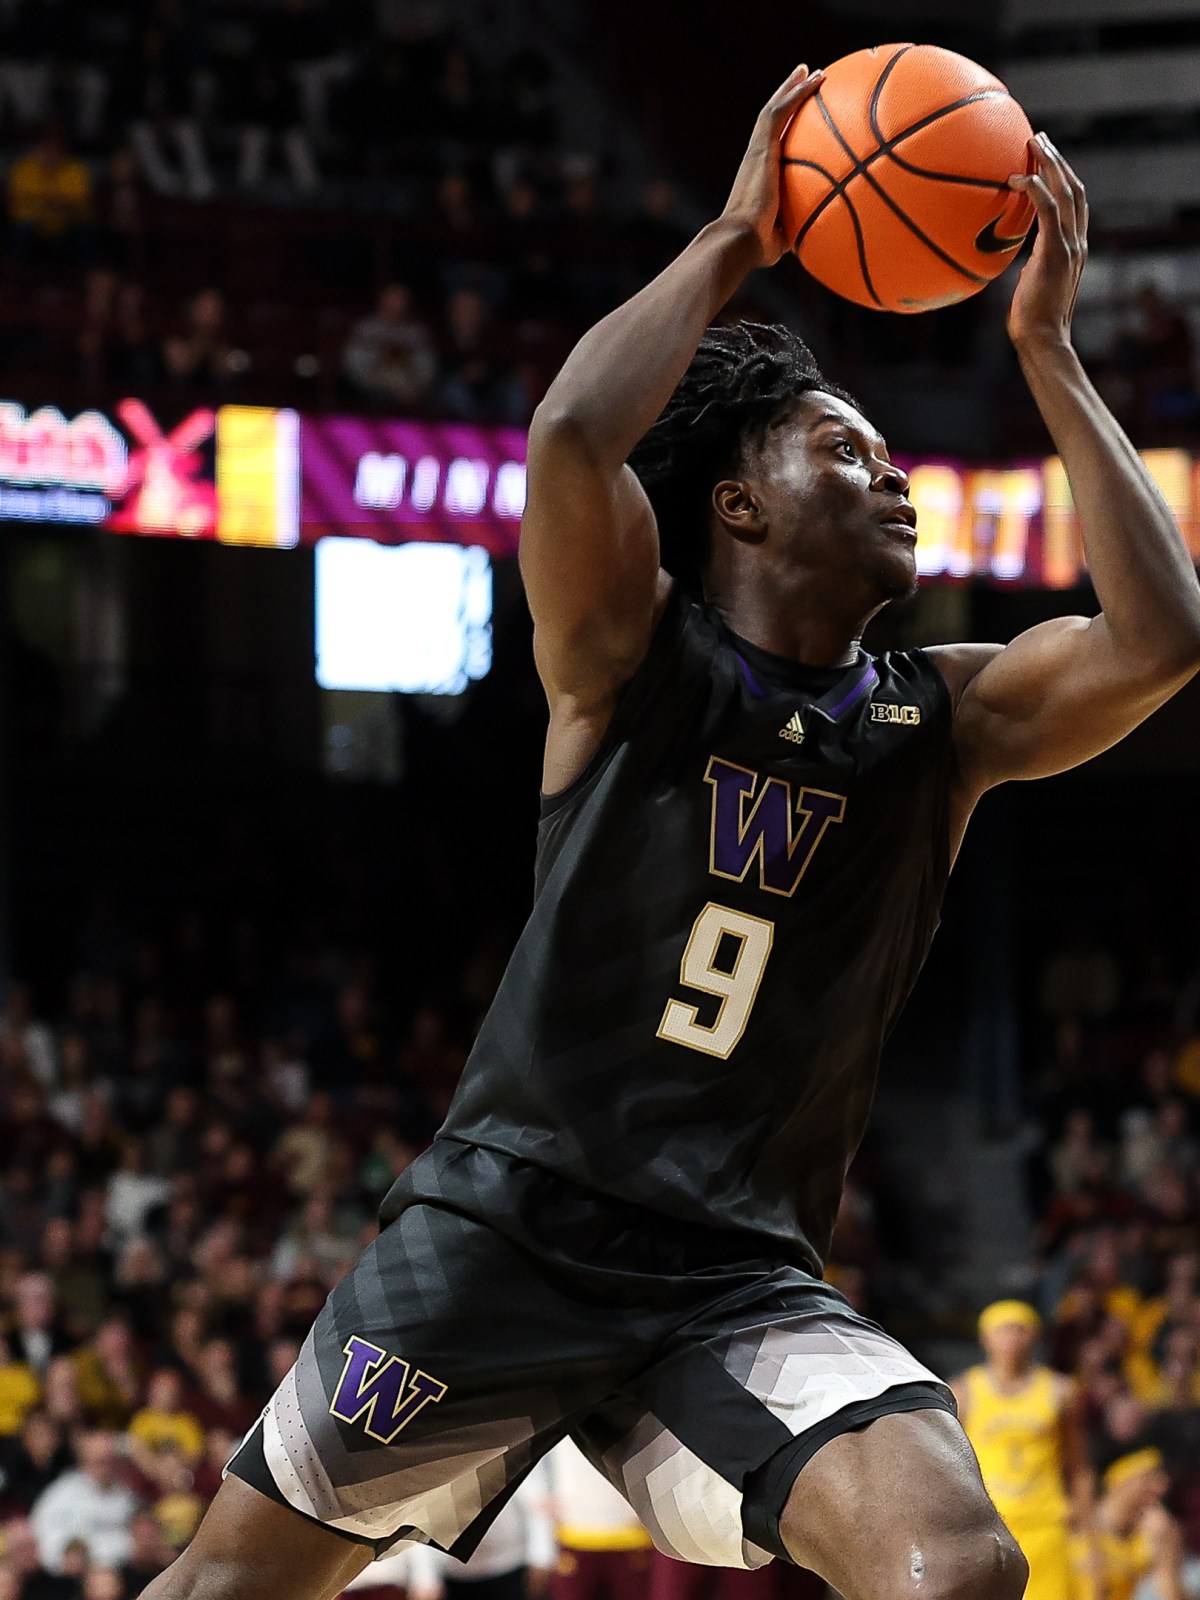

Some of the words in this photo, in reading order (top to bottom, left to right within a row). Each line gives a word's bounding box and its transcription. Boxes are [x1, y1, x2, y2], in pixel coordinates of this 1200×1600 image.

[703, 755, 847, 897] W
[656, 902, 775, 1060] 9
[329, 1335, 449, 1445] W
